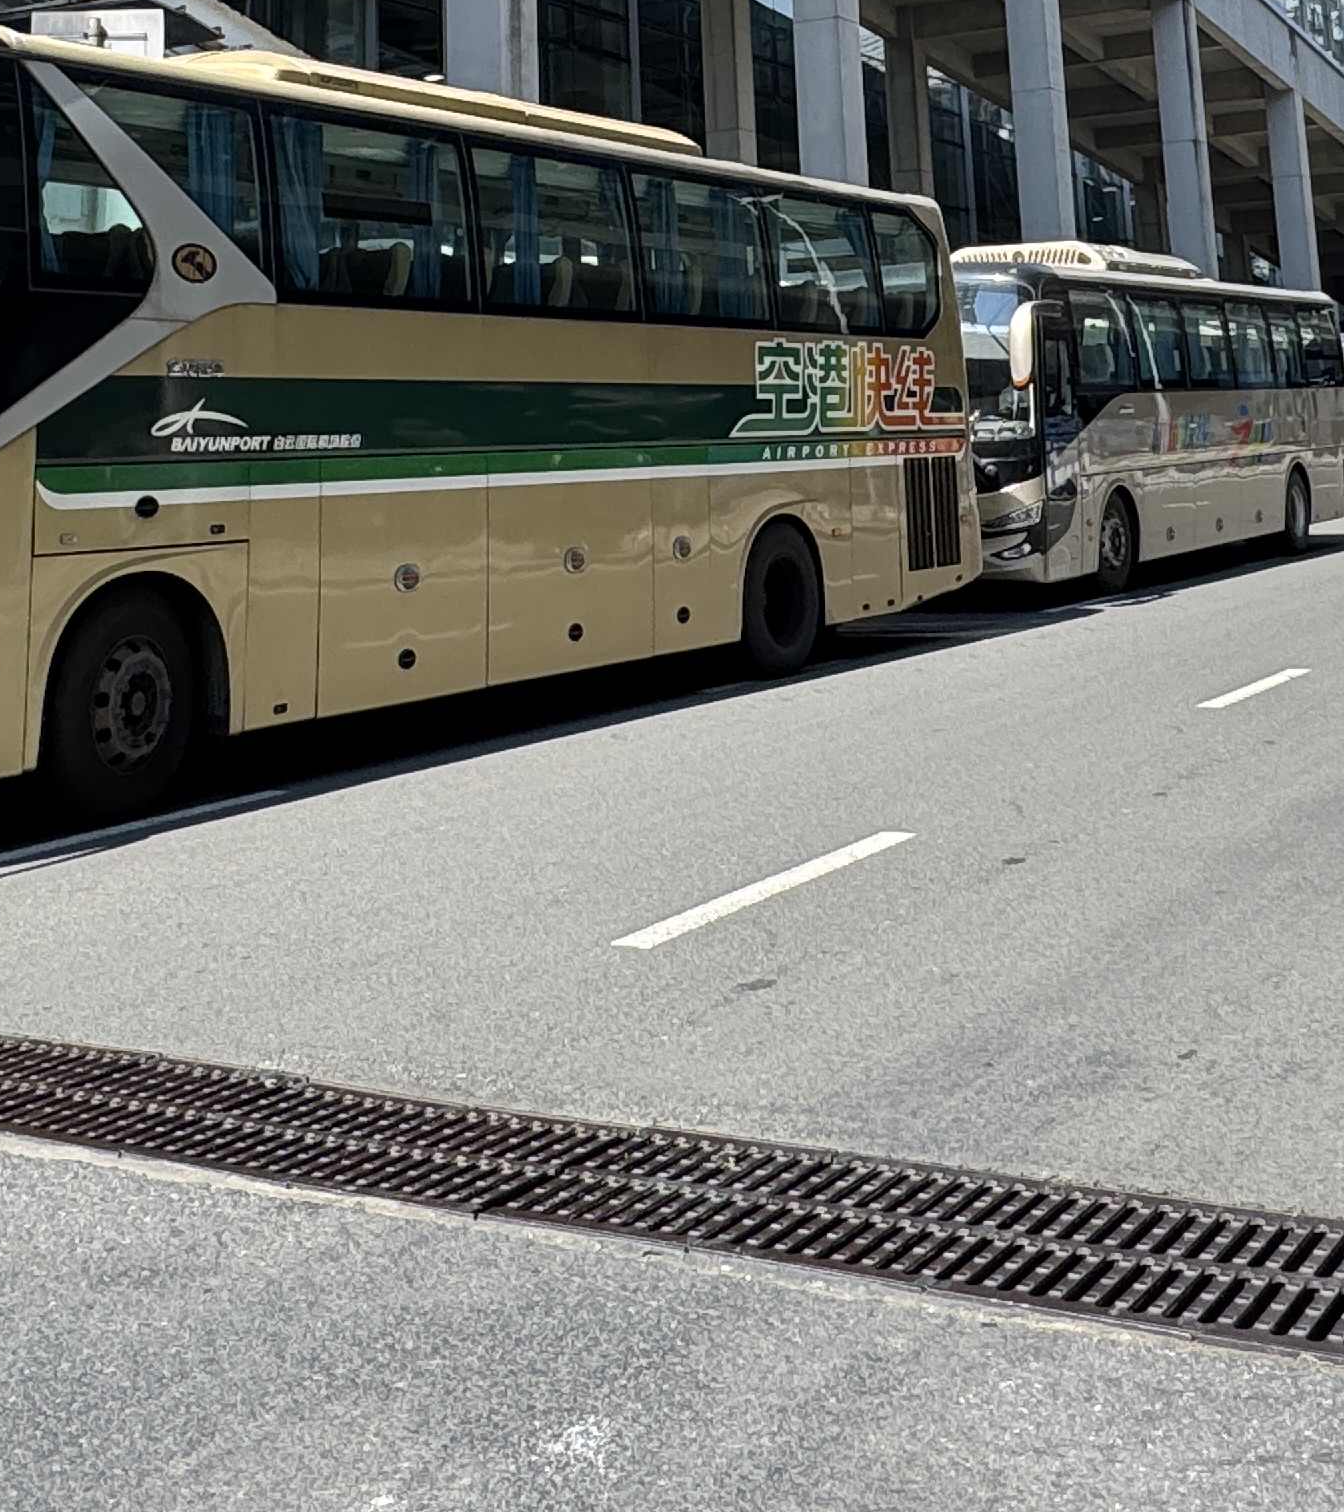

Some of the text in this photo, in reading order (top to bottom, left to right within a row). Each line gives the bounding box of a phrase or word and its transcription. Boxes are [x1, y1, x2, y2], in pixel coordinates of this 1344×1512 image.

[729, 337, 965, 437] 空港快线
[171, 435, 271, 452] BAIYUNPORT
[762, 441, 937, 460] AIRPORT EXPRESS
